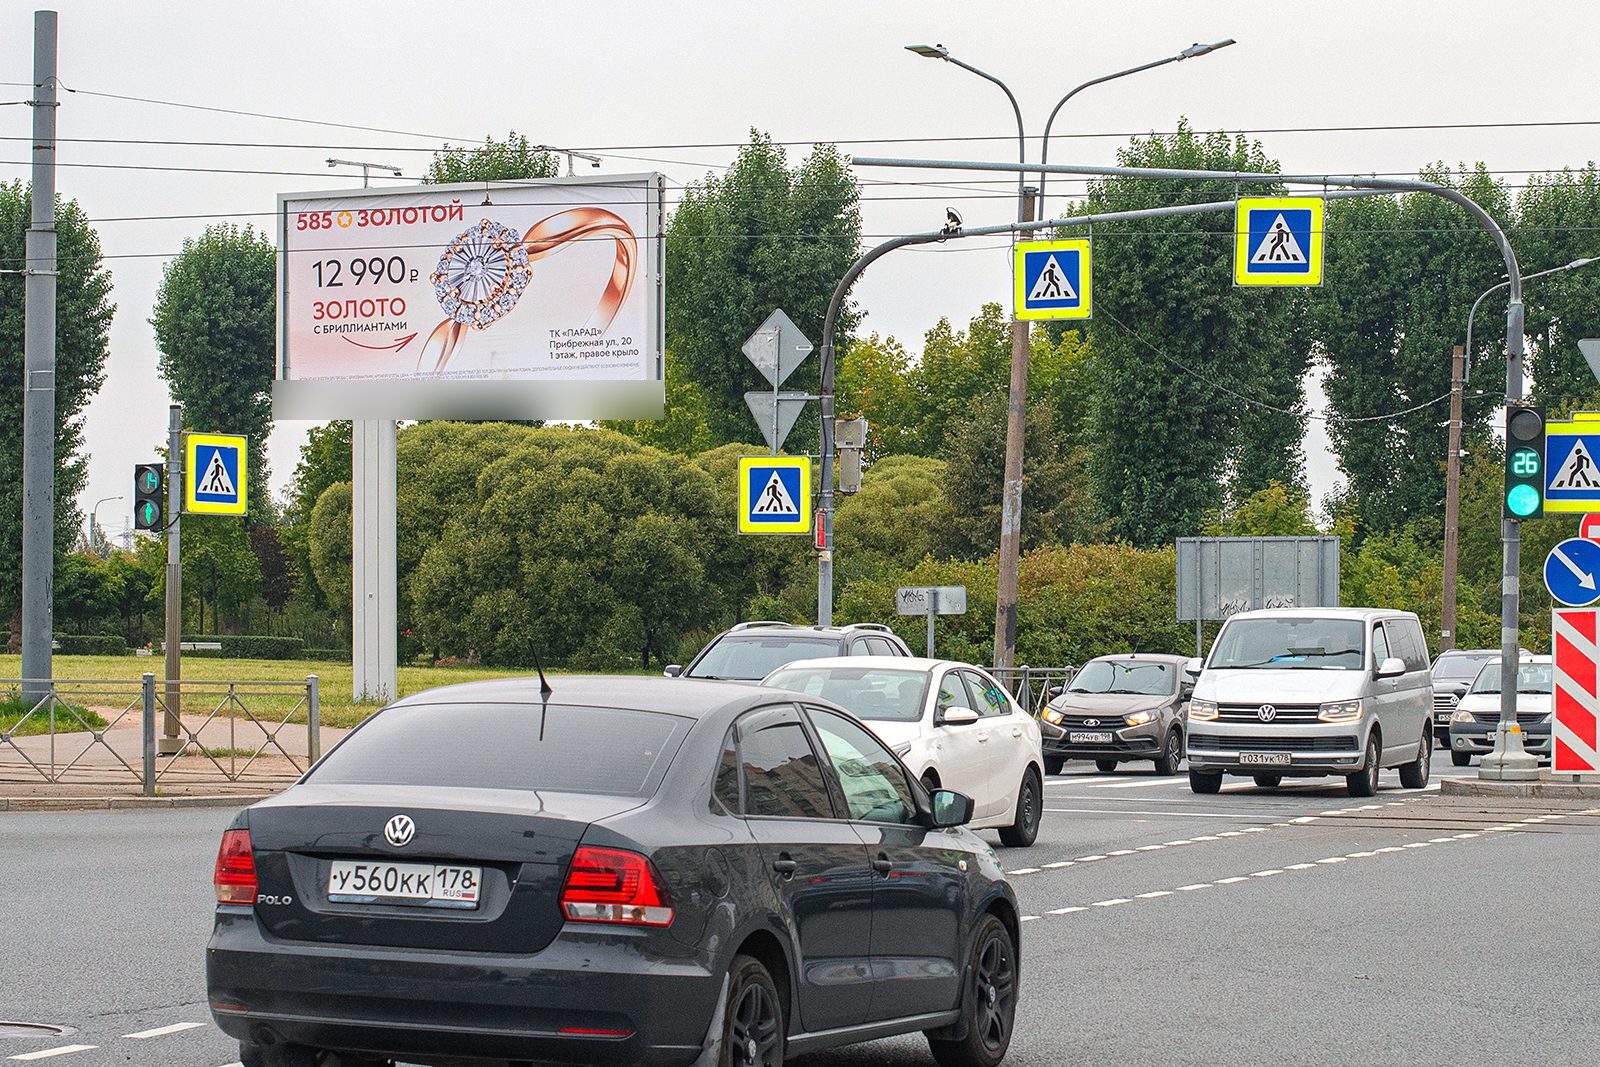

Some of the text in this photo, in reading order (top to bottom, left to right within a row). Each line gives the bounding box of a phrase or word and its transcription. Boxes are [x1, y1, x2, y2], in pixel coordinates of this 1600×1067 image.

[296, 199, 464, 231] 585 ЗОЛОТОЙ
[313, 297, 406, 320] ЗОЛОТО
[313, 321, 408, 335] С БРИЛЛИАНТАМИ
[549, 327, 602, 338] ТК «ПАРАД»
[549, 337, 632, 350] Прибрежная ул., 20
[549, 348, 640, 360] 1 этаж, правое крыло
[1513, 452, 1538, 474] 26
[437, 868, 473, 889] 178
[443, 888, 462, 897] RUS
[257, 894, 293, 905] POLO
